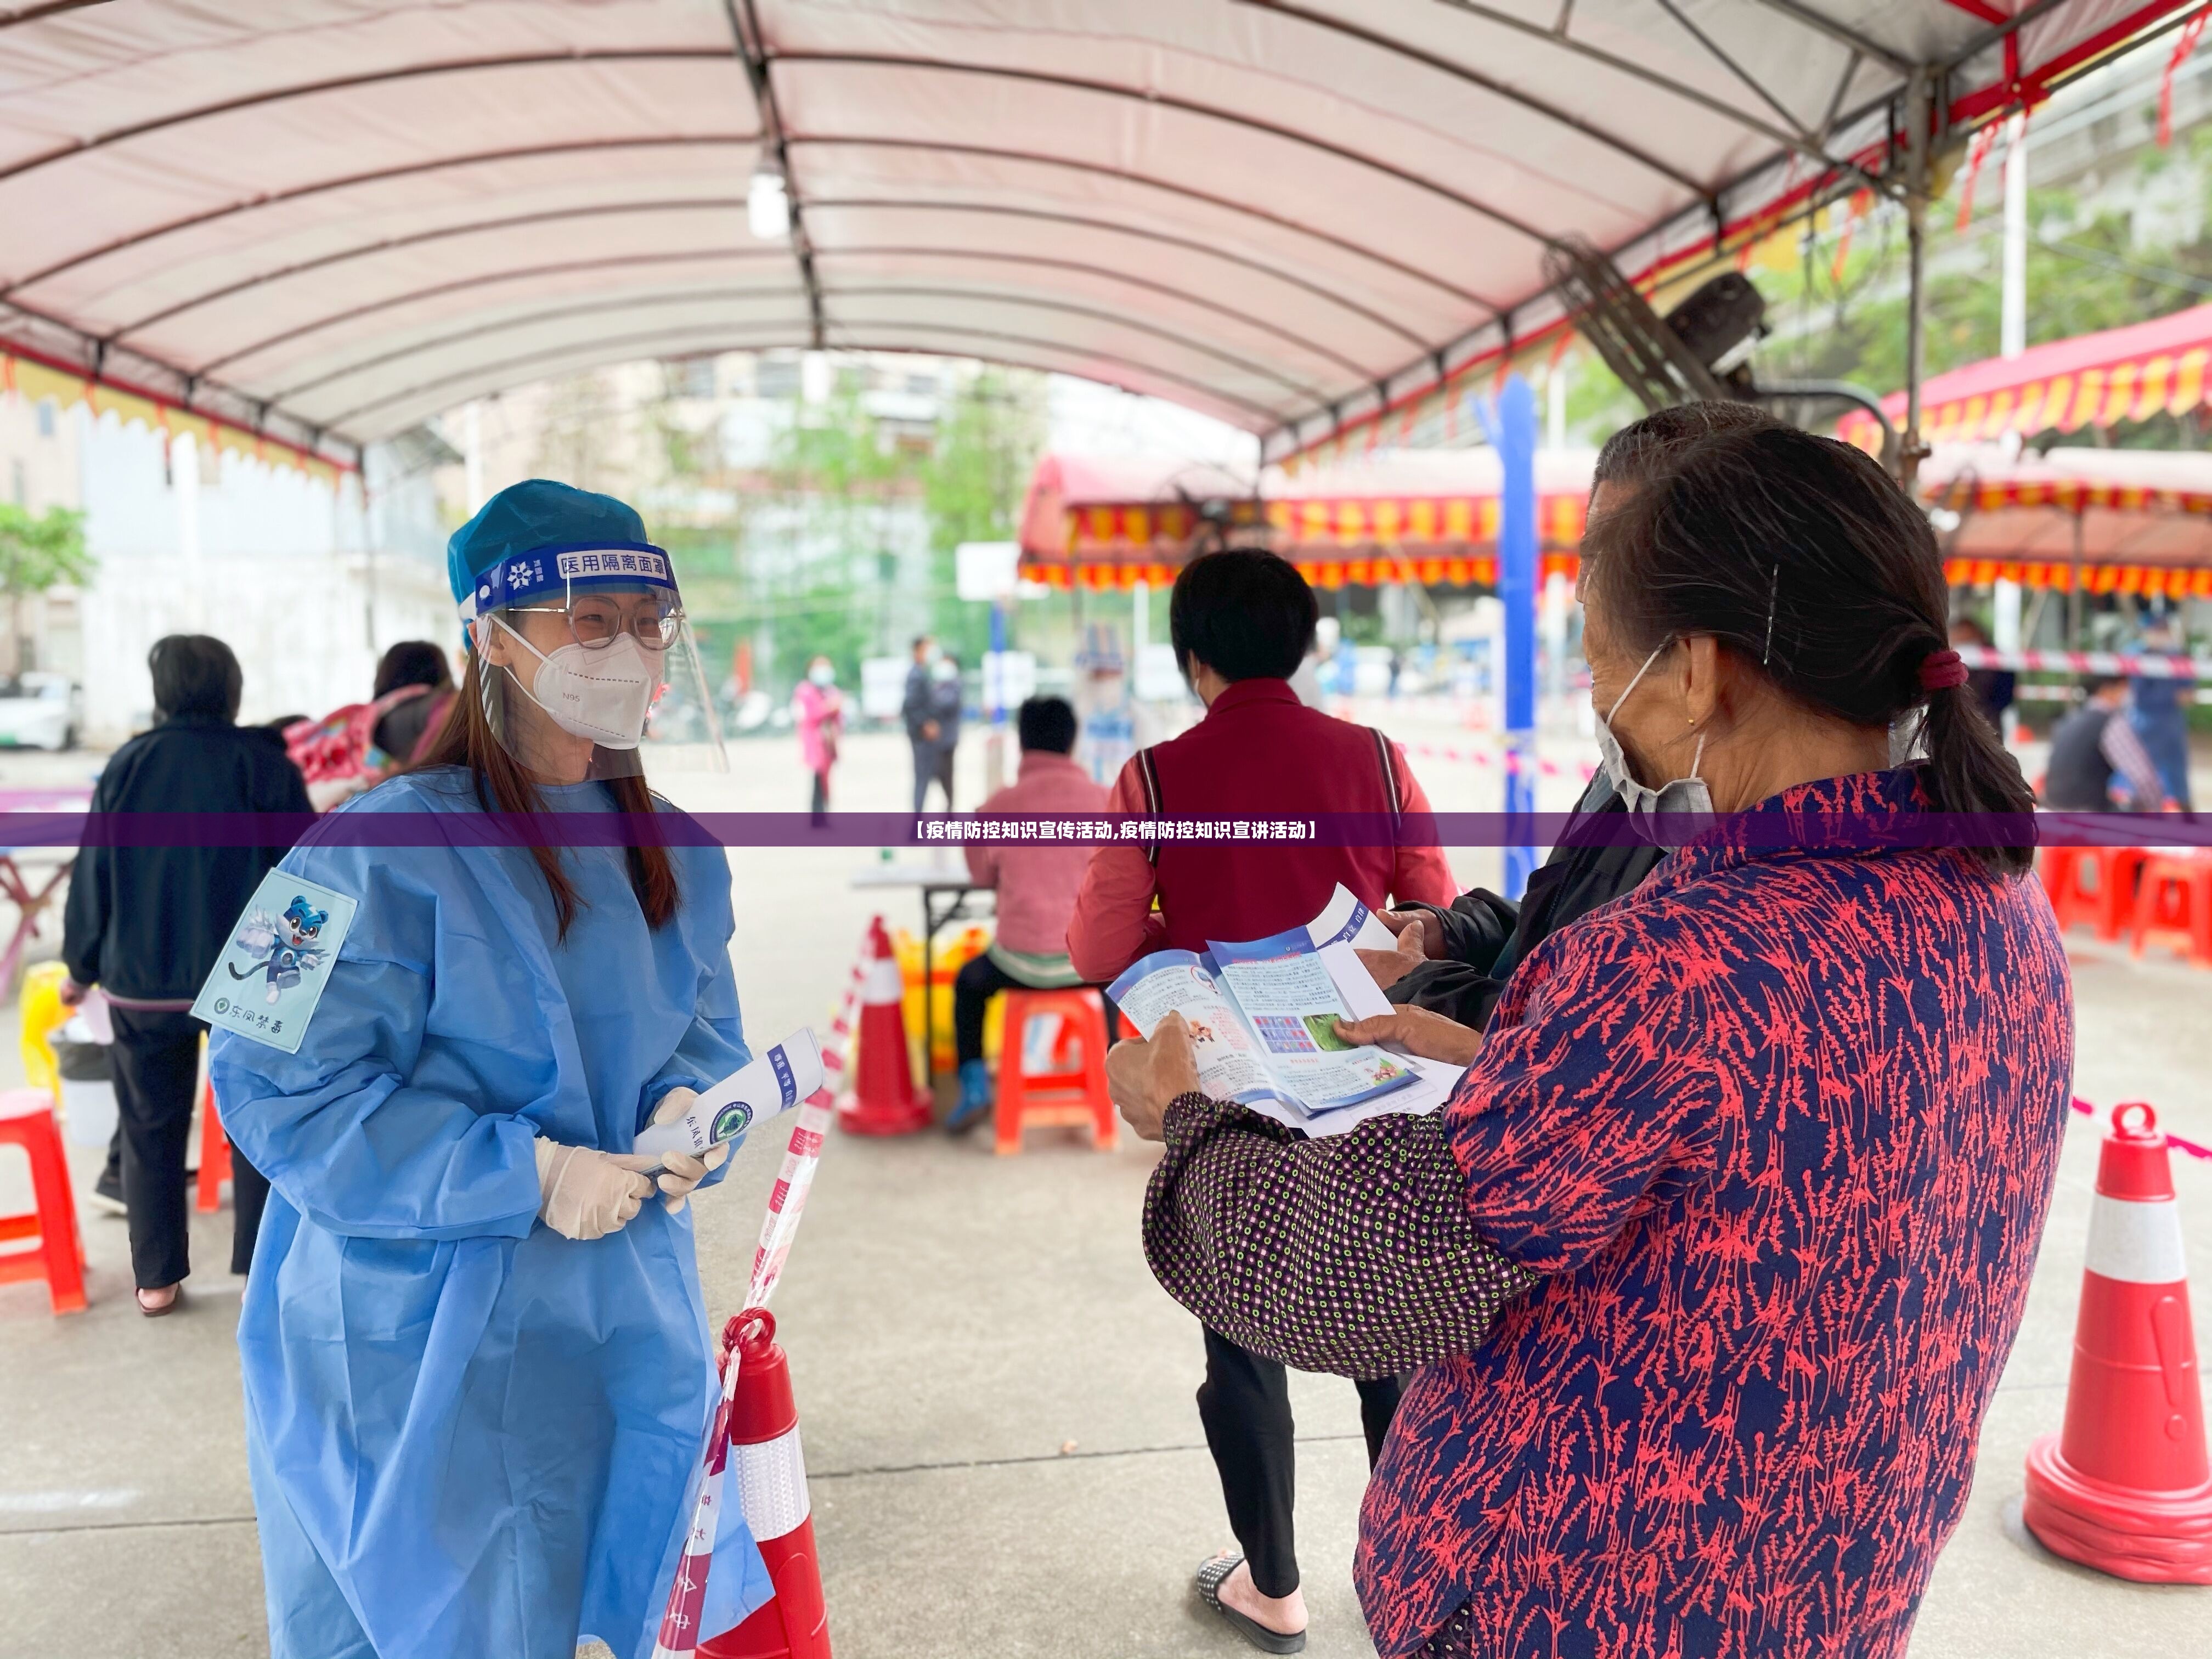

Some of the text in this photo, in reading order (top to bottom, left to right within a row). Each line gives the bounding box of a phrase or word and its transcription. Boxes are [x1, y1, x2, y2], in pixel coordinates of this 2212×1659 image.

[561, 554, 665, 575] 医用隔离面罩
[563, 692, 580, 702] N95
